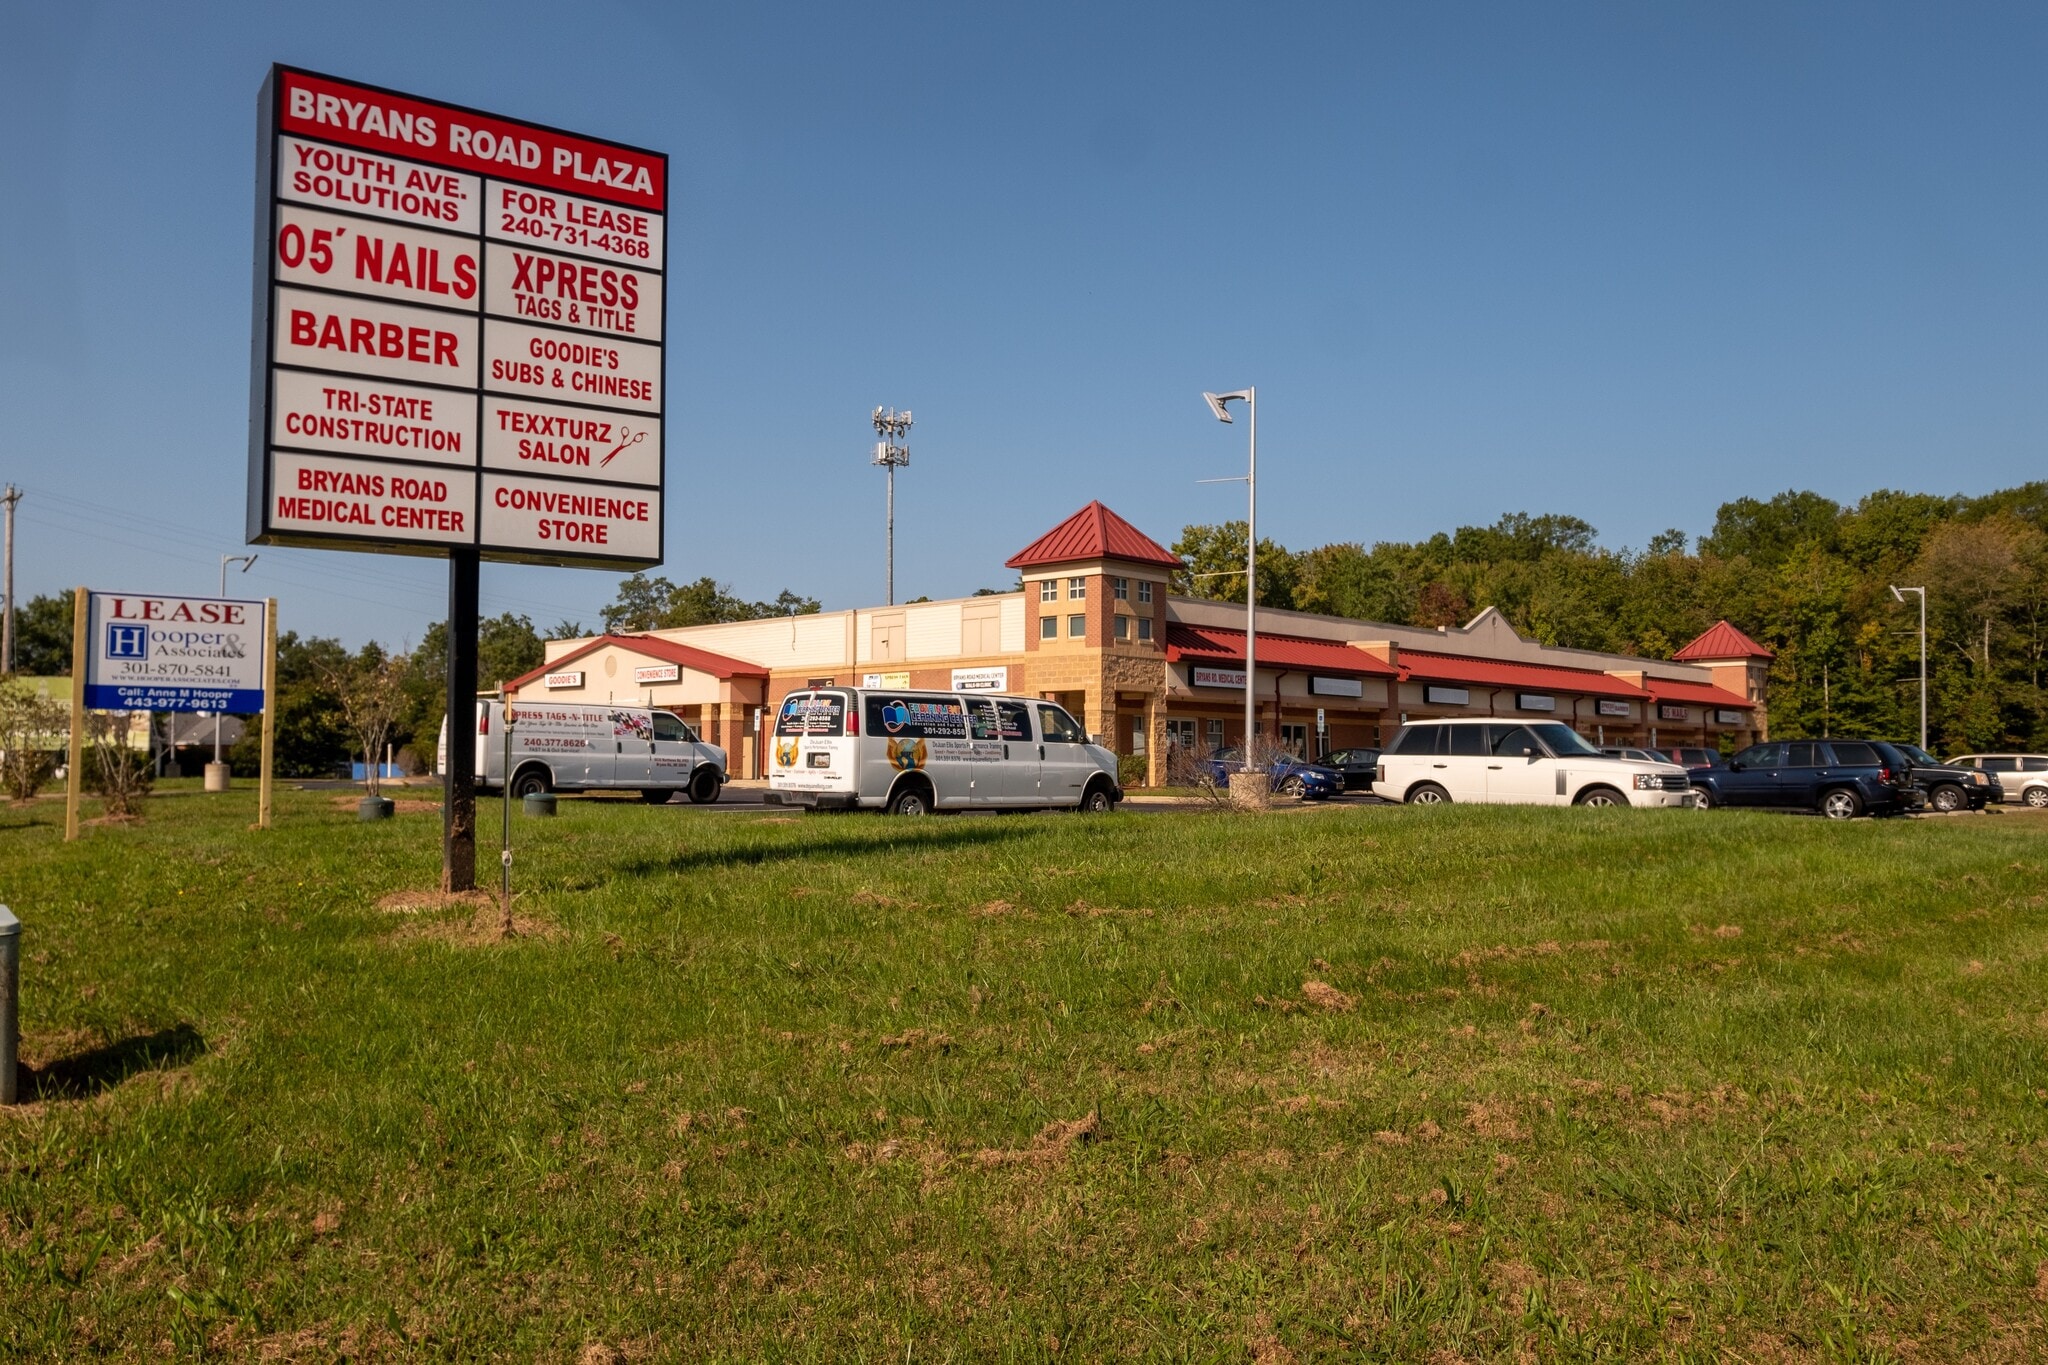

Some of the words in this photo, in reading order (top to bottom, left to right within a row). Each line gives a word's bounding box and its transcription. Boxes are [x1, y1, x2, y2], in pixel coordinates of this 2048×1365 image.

[289, 86, 437, 148] BRYANS
[448, 123, 542, 170] ROAD
[552, 146, 654, 196] PLAZA
[294, 143, 396, 185] YOUTH
[405, 169, 468, 200] AVE.
[293, 171, 459, 223] SOLUTIONS
[501, 188, 556, 219] FOR
[566, 202, 649, 238] LEASE
[501, 213, 650, 260] 240-731-4368
[355, 234, 478, 300] NAILS
[511, 252, 639, 311] XPRESS
[515, 292, 562, 321] TAGS
[567, 303, 581, 324] &
[586, 305, 636, 334] TITLE
[290, 308, 460, 368] BARBER
[529, 337, 620, 371] GOODIE'S
[492, 359, 545, 387] SUBS
[551, 367, 565, 389] &
[571, 371, 652, 402] CHINESE
[322, 387, 433, 422] TRI-STATE
[285, 412, 461, 453] CONSTRUCTION
[496, 409, 612, 444] TEXXTURZ
[518, 439, 591, 467] SALON
[298, 467, 385, 498] BRYANS
[390, 477, 448, 503] ROAD
[278, 496, 376, 527] MEDICAL
[381, 505, 465, 533] CENTER
[494, 487, 649, 523] CONVENIENCE
[537, 518, 608, 545] STORE
[111, 598, 245, 625] LEASE
[154, 644, 245, 659] Associates
[120, 661, 232, 678] 301-870-5841
[548, 674, 577, 686] GOODIE'S
[636, 669, 663, 680] CONVENIENCE
[663, 668, 677, 679] STORE
[1218, 673, 1234, 684] MEDICAL
[1235, 674, 1247, 685] CENTE
[117, 687, 144, 697] Call:
[147, 688, 176, 698] Anne
[179, 689, 190, 698] M
[193, 690, 233, 700] Hooper
[546, 711, 567, 721] TAGS
[581, 713, 604, 723] TITLE
[911, 713, 949, 723] LEARNING
[1671, 708, 1689, 718] NAILS
[523, 738, 586, 748] 240.377.8626
[923, 727, 966, 736] 301-292-858
